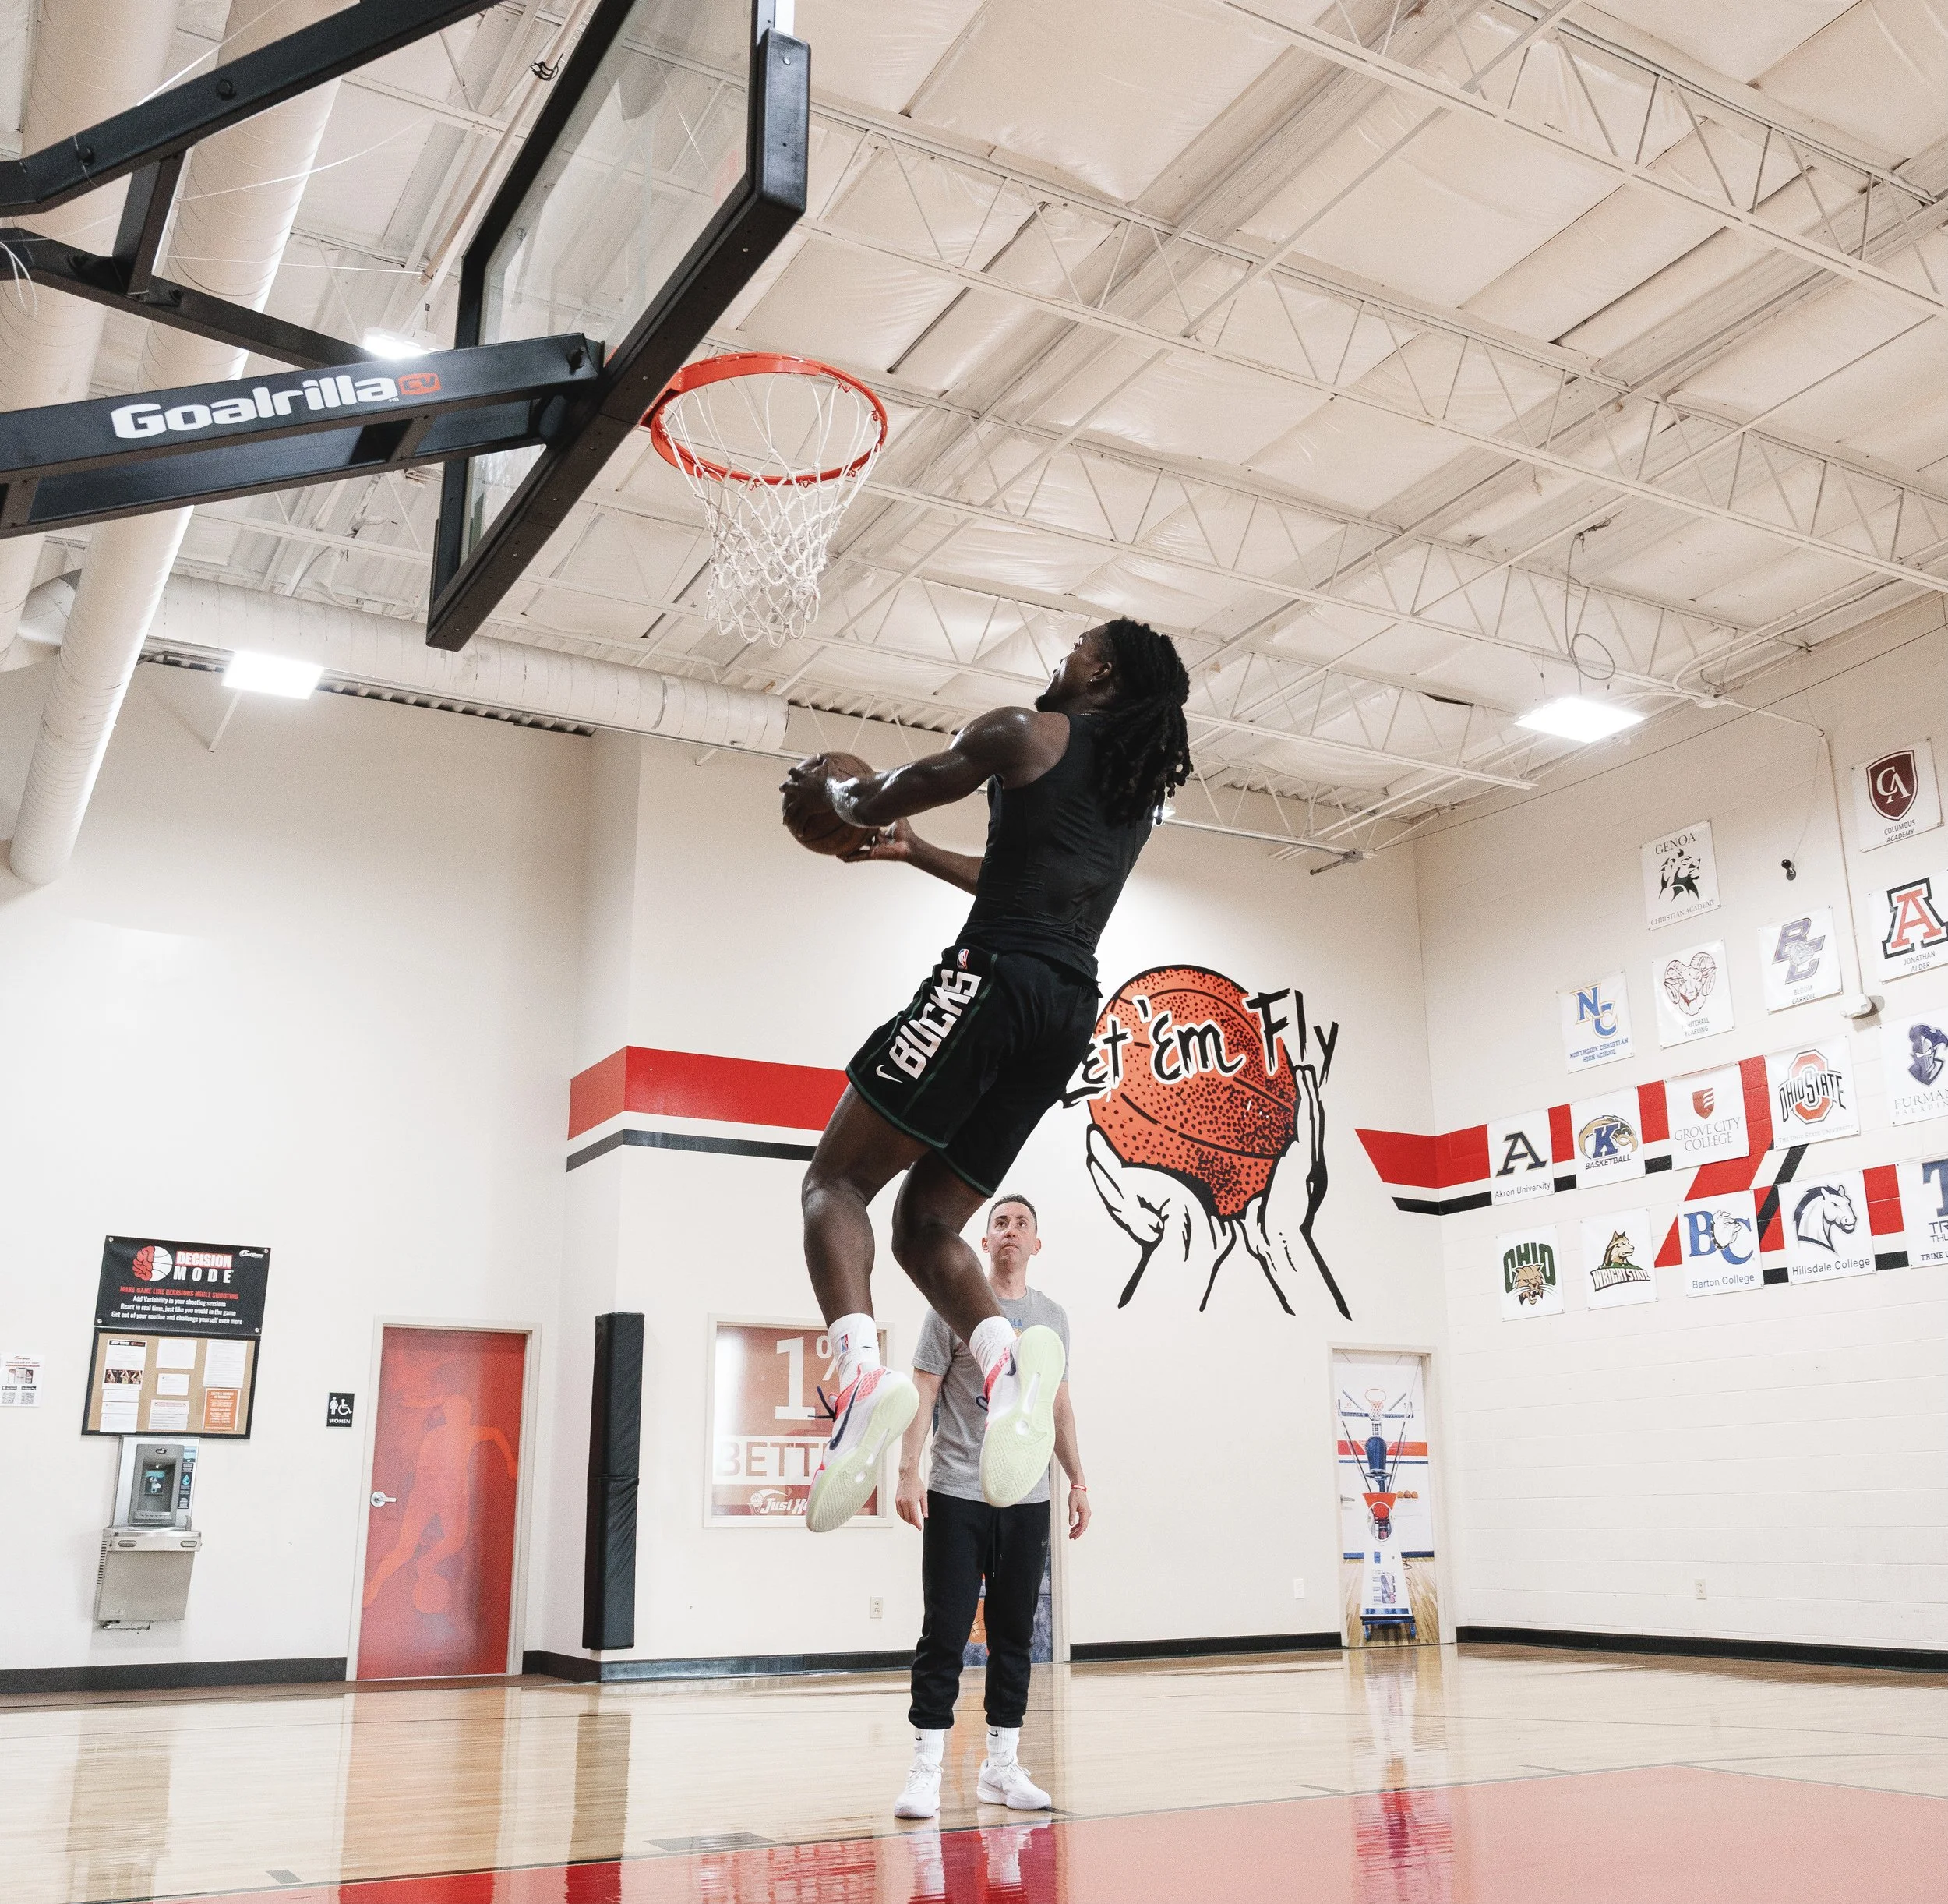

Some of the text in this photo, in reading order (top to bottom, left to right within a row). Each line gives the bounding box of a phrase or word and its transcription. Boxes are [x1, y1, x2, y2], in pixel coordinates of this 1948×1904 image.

[111, 375, 398, 439] Goalrilla
[1884, 819, 1916, 835] COLUMBUS
[1886, 828, 1914, 842] ACADEMY
[1655, 832, 1696, 855] GENOA
[1650, 910, 1685, 925] CHRISTIAN
[1883, 878, 1948, 959] A
[1904, 951, 1936, 966] JONATHAN
[1911, 962, 1930, 973] ALDER
[1571, 984, 1618, 1039] NC
[889, 969, 982, 1079] BUCKS
[1247, 988, 1339, 1088] Fly
[1569, 1037, 1629, 1058] NORTHSIDE CHRISTIAN
[1596, 1049, 1616, 1059] SCHOOL
[1895, 1089, 1948, 1110] FURMA
[1675, 1117, 1741, 1141] GROVE CITY
[1593, 1122, 1620, 1159] K
[1685, 1131, 1734, 1152] COLLEGE
[1495, 1131, 1548, 1178] A
[1585, 1154, 1632, 1171] BASKETBALL
[1495, 1182, 1551, 1199] Akron University
[1684, 1210, 1753, 1265] BC
[176, 1252, 232, 1268] DECISION
[1921, 1252, 1943, 1261] TRINE
[173, 1266, 231, 1284] MODE
[1503, 1242, 1556, 1294] OHIO
[1792, 1258, 1871, 1276] Hillsdale College
[1692, 1274, 1755, 1289] Barton College
[120, 1302, 135, 1311] React
[760, 1497, 794, 1514] Just
